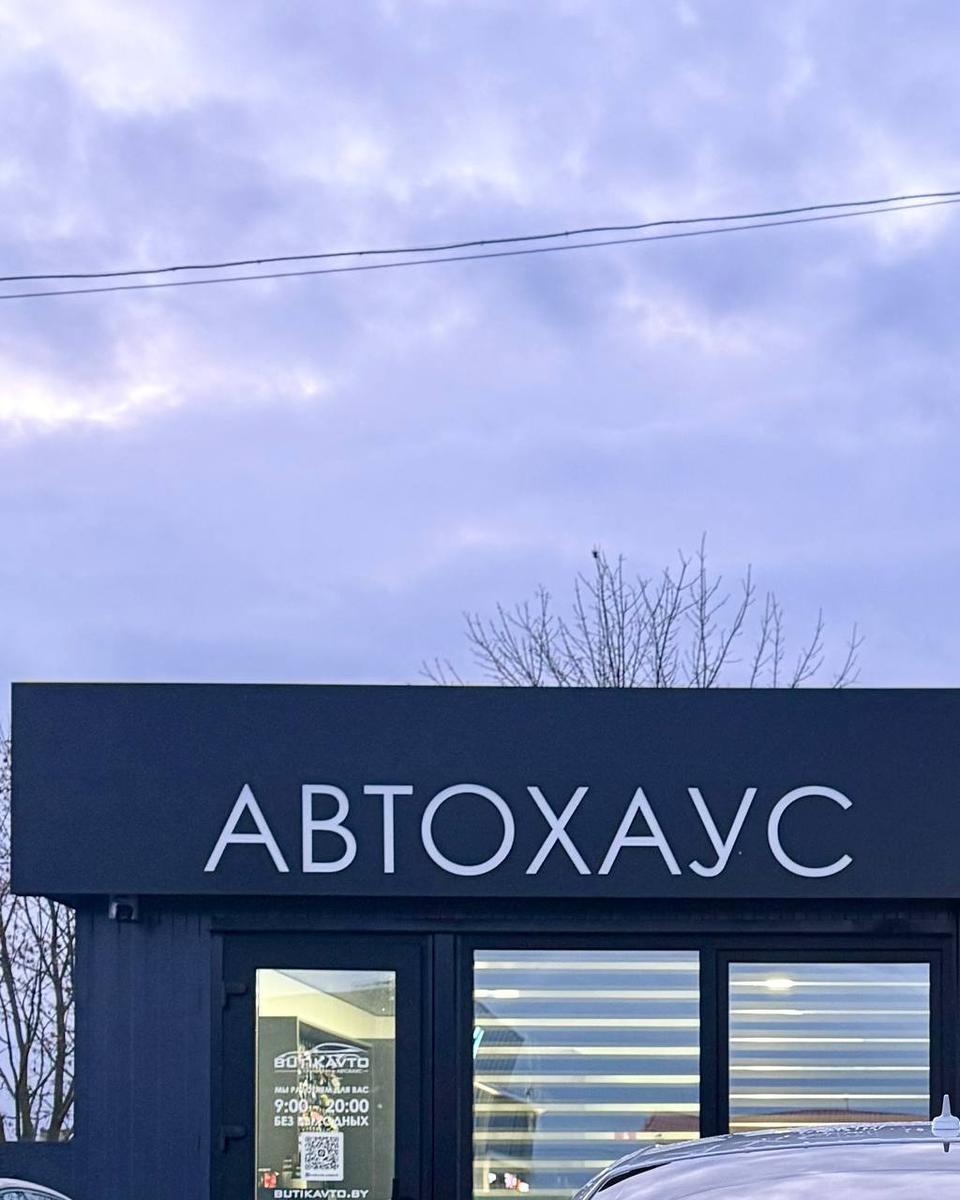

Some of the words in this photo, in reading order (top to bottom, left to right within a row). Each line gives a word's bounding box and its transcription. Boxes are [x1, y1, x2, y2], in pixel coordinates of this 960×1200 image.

[204, 783, 855, 878] АВТОХАУС
[274, 1099, 308, 1113] 9:00
[325, 1099, 369, 1113] 20:00
[274, 1116, 294, 1126] БЕЗ
[274, 1189, 369, 1198] BUTIKAVTO.BY
